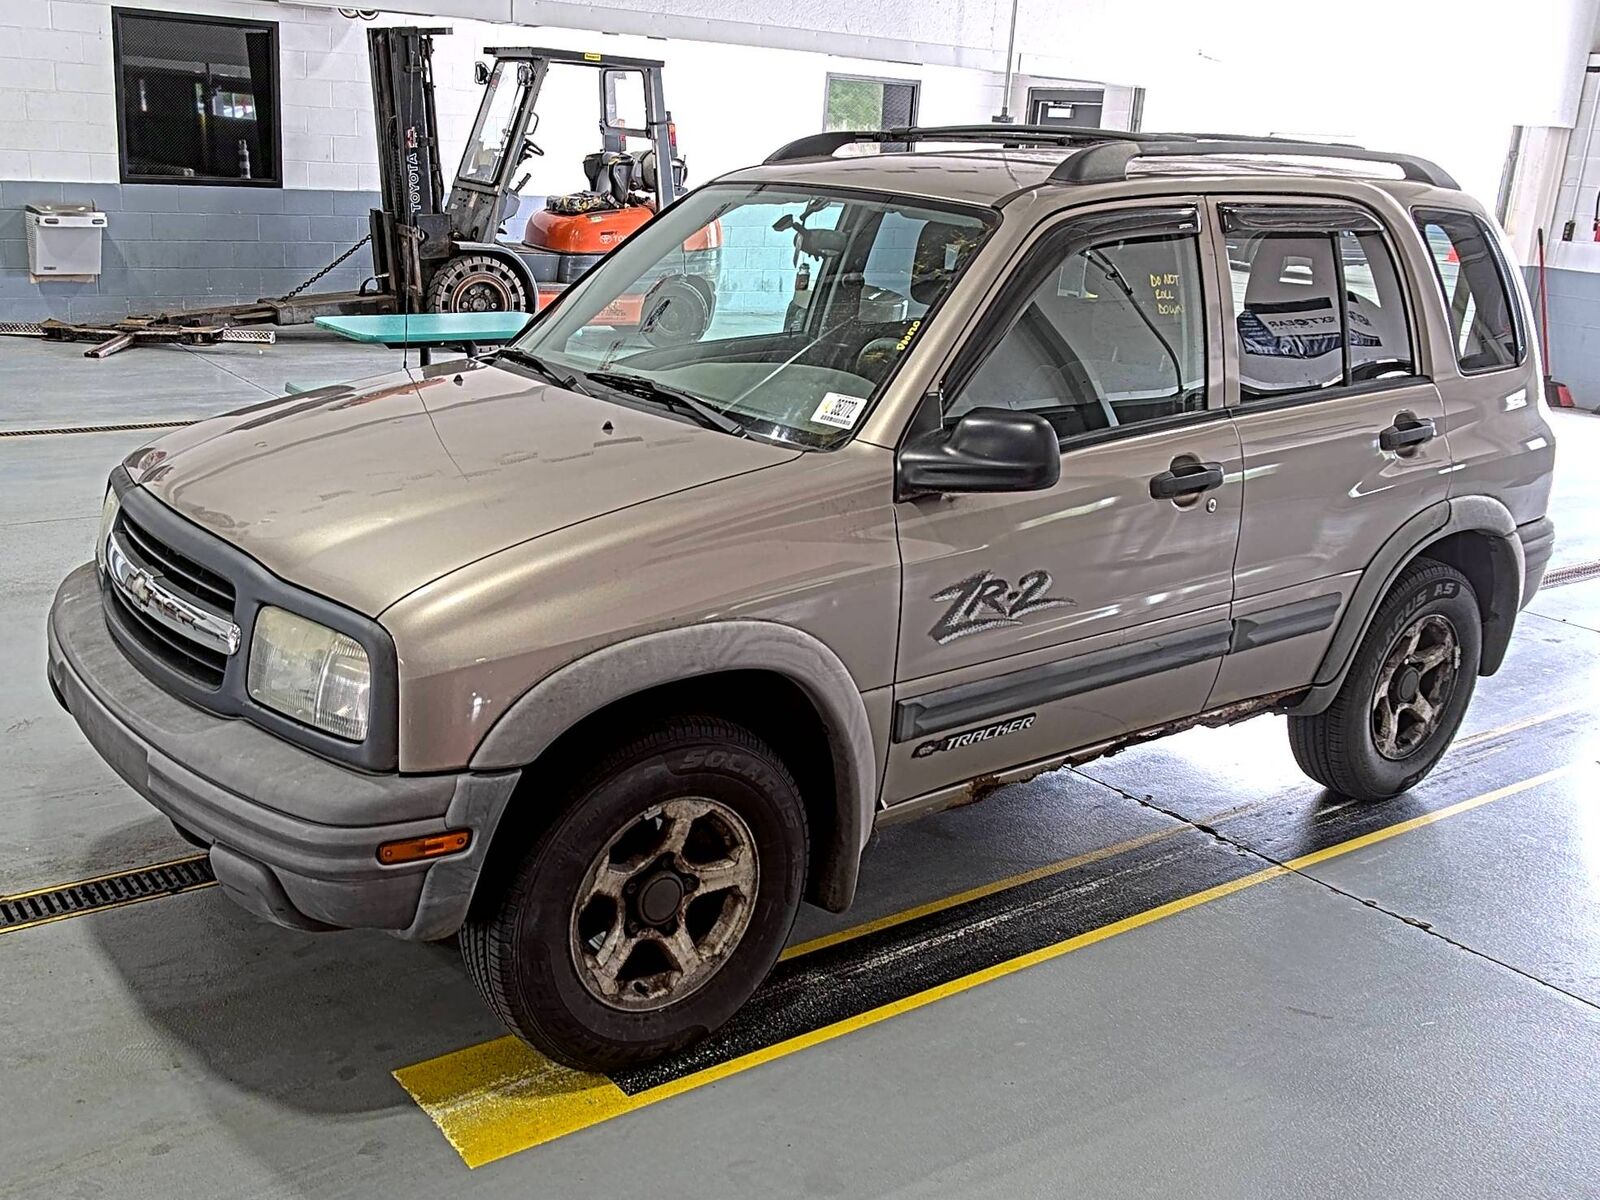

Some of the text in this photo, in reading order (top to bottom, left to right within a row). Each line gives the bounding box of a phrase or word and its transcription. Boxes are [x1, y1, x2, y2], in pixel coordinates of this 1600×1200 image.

[407, 152, 421, 213] TOYOTA
[1150, 273, 1180, 287] DO NOT
[1157, 303, 1185, 315] DOWN
[1433, 582, 1456, 597] AS
[946, 715, 1036, 751] TRACKER
